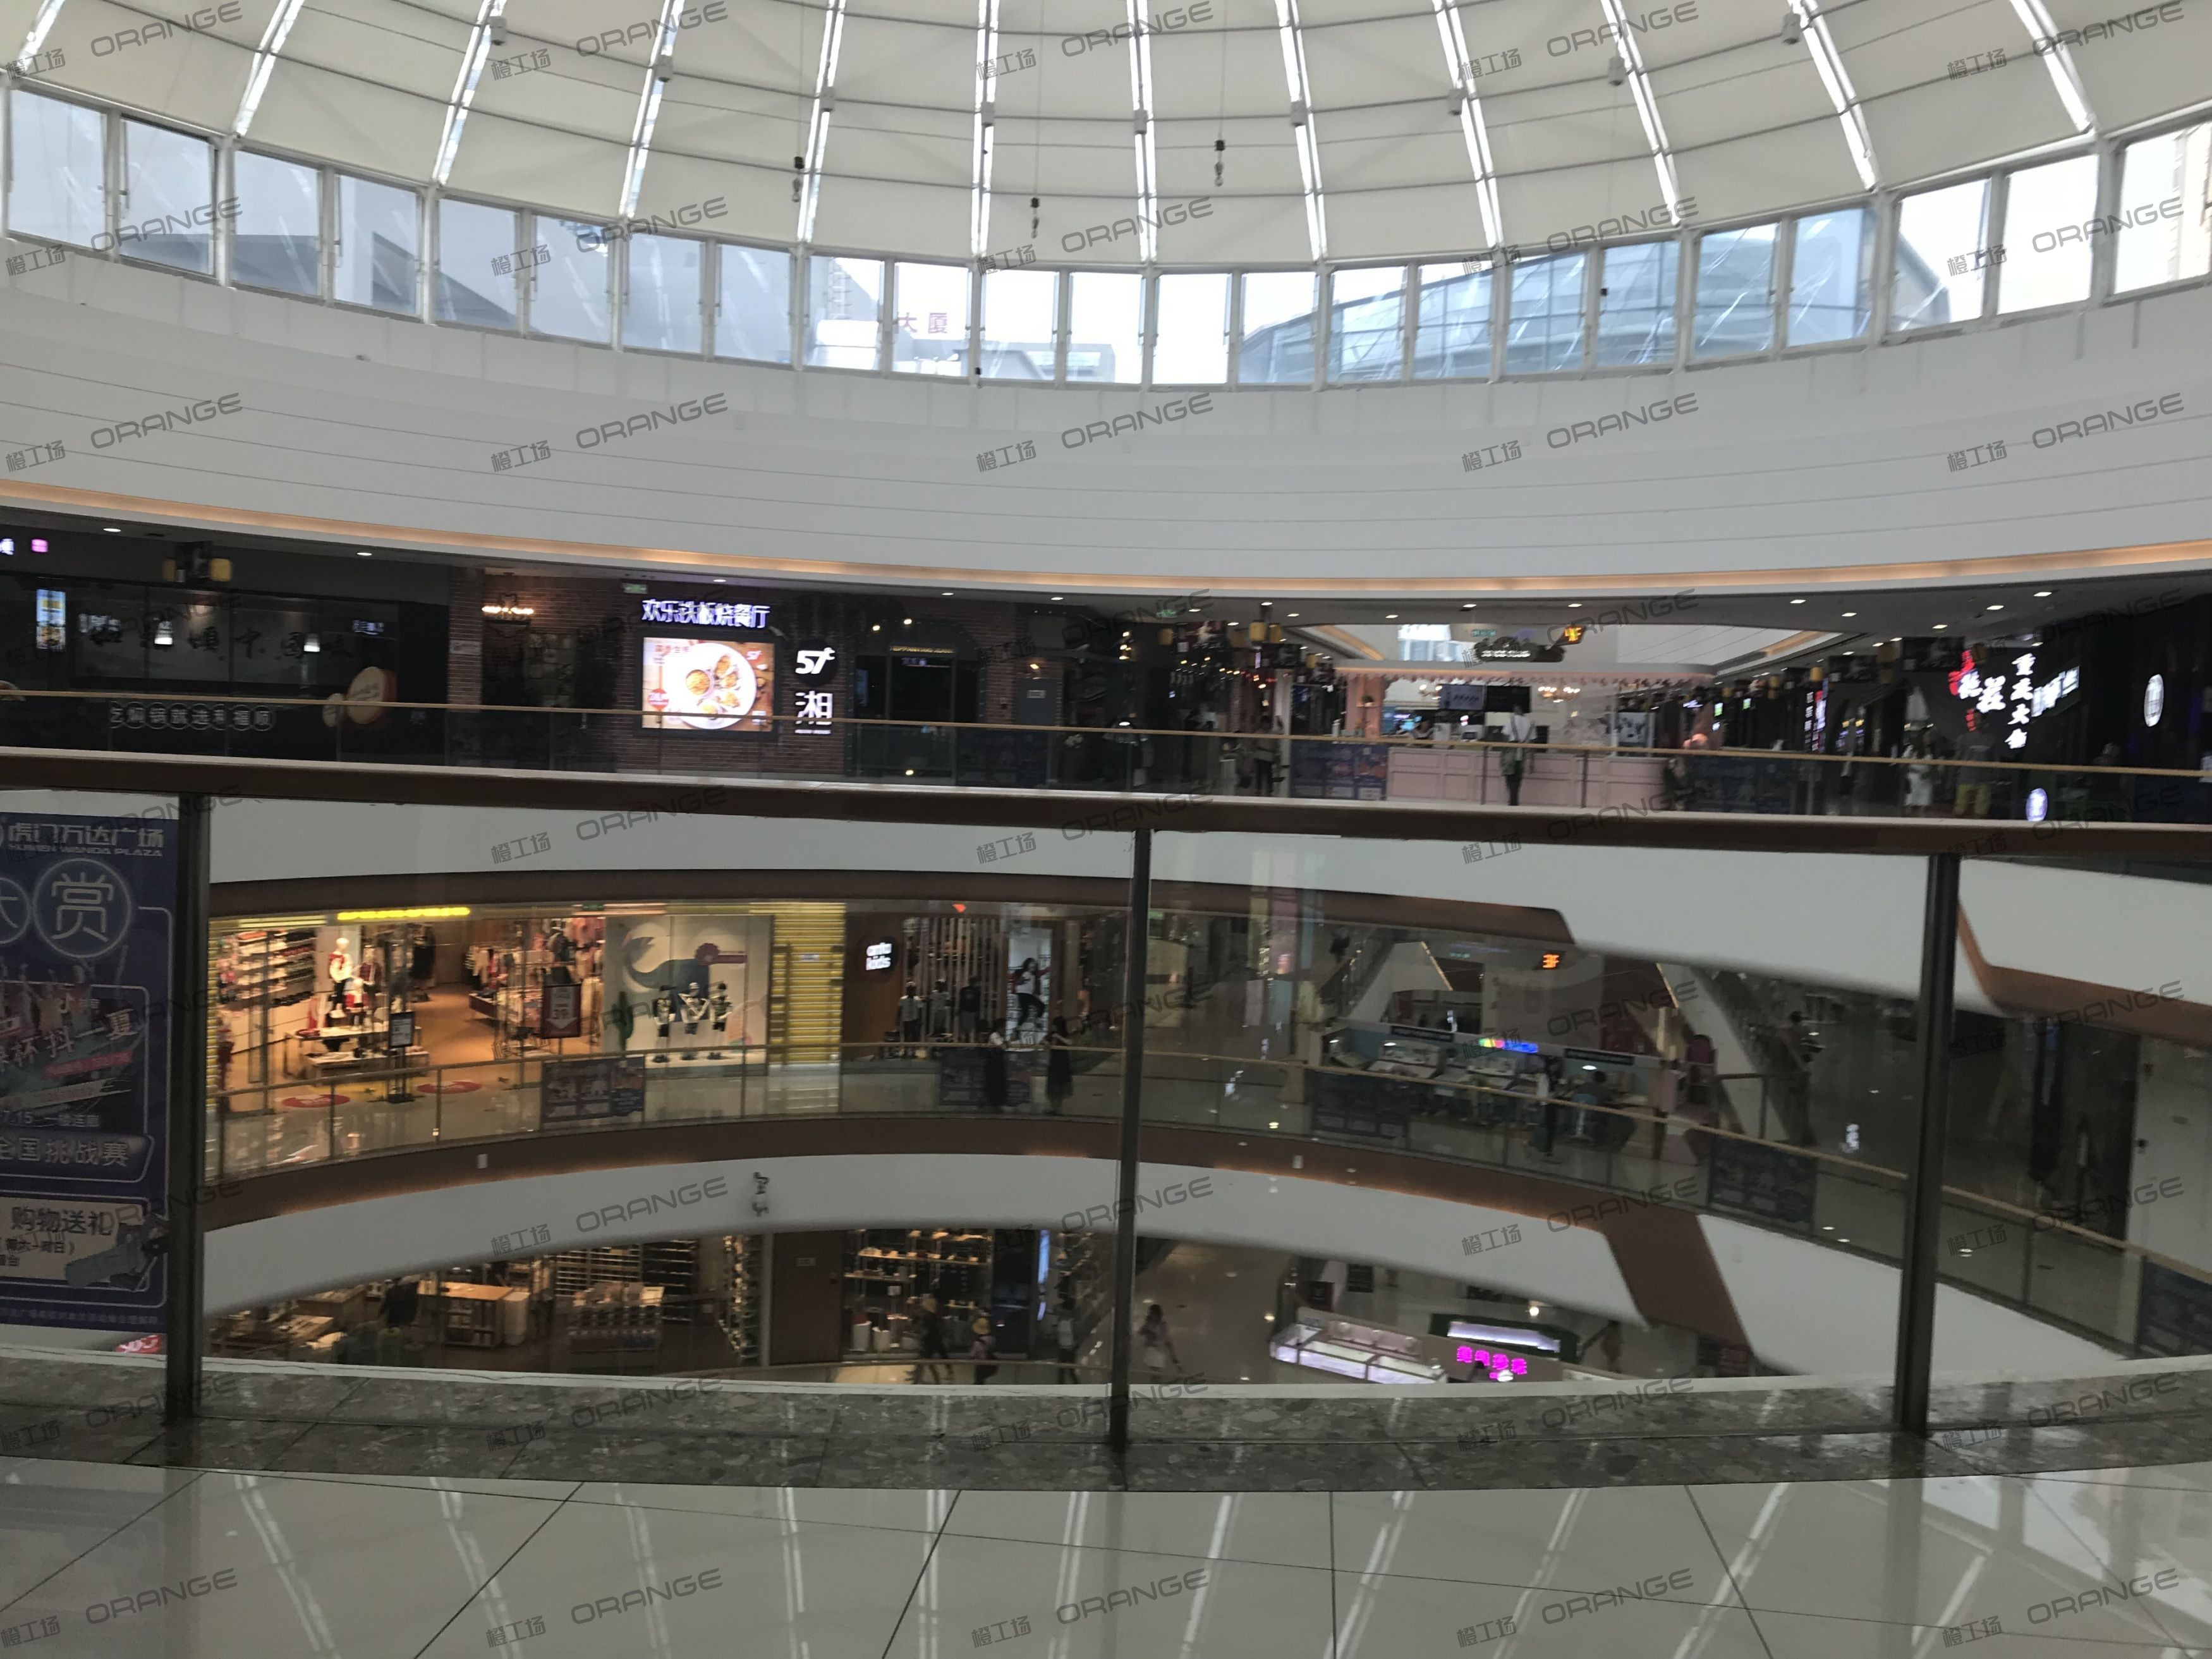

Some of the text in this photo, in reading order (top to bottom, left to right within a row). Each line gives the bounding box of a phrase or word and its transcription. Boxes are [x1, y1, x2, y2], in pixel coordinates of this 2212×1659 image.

[641, 599, 770, 628] 欢乐铁板烧餐厅
[8, 822, 164, 848] 虎门万达广场
[114, 848, 163, 857] PLAZA
[0, 1135, 129, 1167] 全国挑战赛
[11, 1206, 113, 1236] 购物送礼
